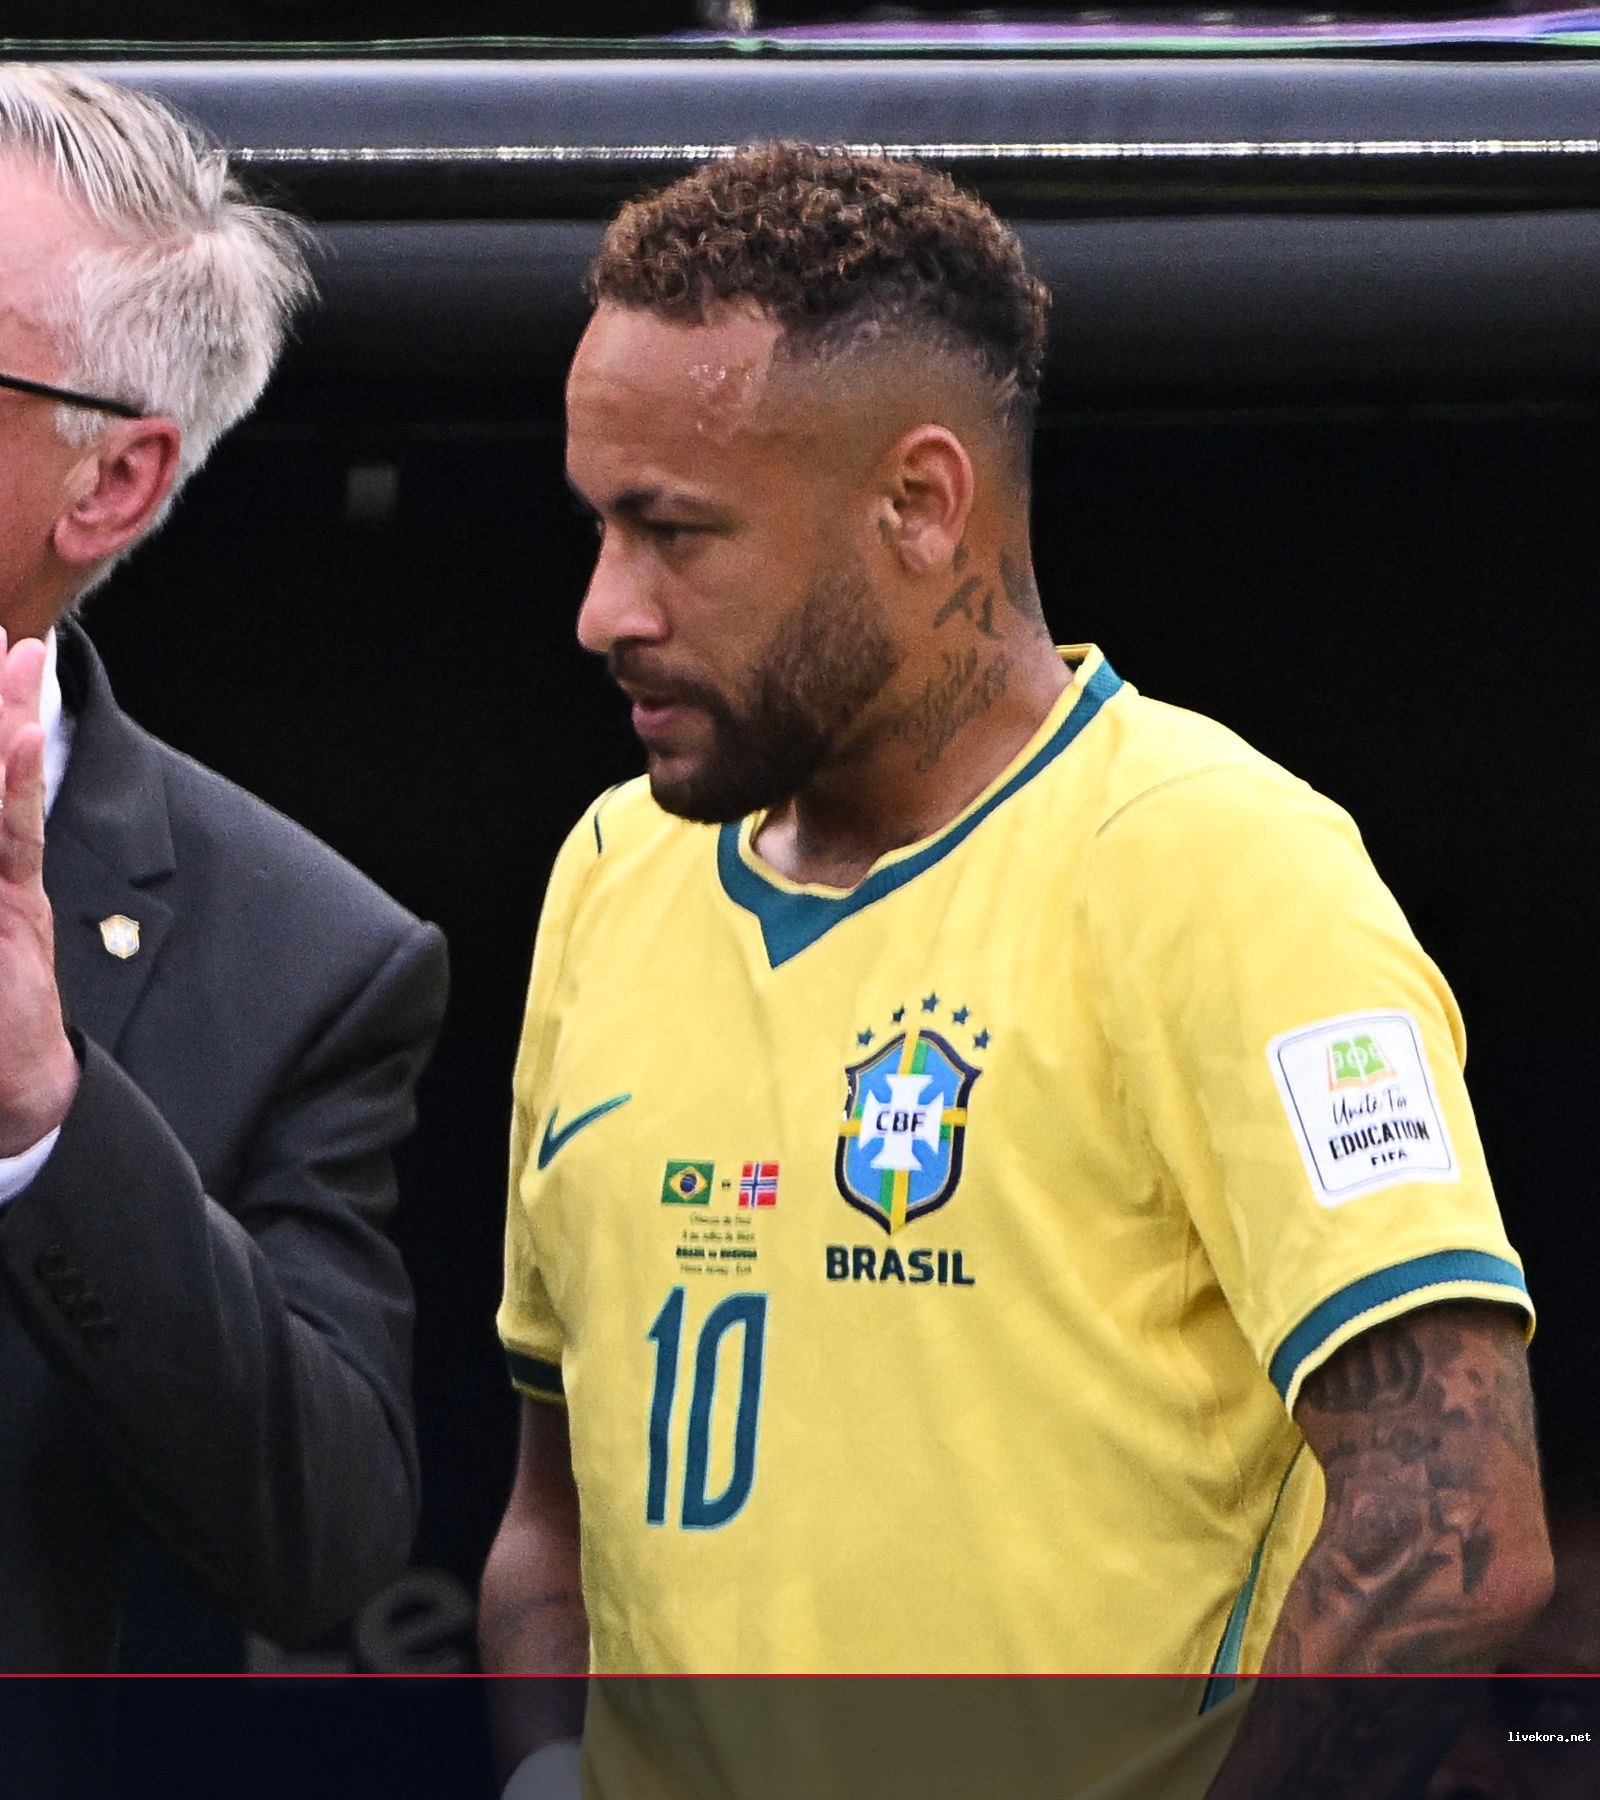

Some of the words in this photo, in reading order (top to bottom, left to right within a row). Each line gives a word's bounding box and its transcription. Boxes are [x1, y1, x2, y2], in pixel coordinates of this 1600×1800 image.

[876, 1110, 927, 1133] CBF
[1329, 1119, 1430, 1161] EDUCATION
[1371, 1148, 1407, 1166] FIFA
[826, 1245, 975, 1285] BRASIL
[645, 1285, 769, 1531] 10
